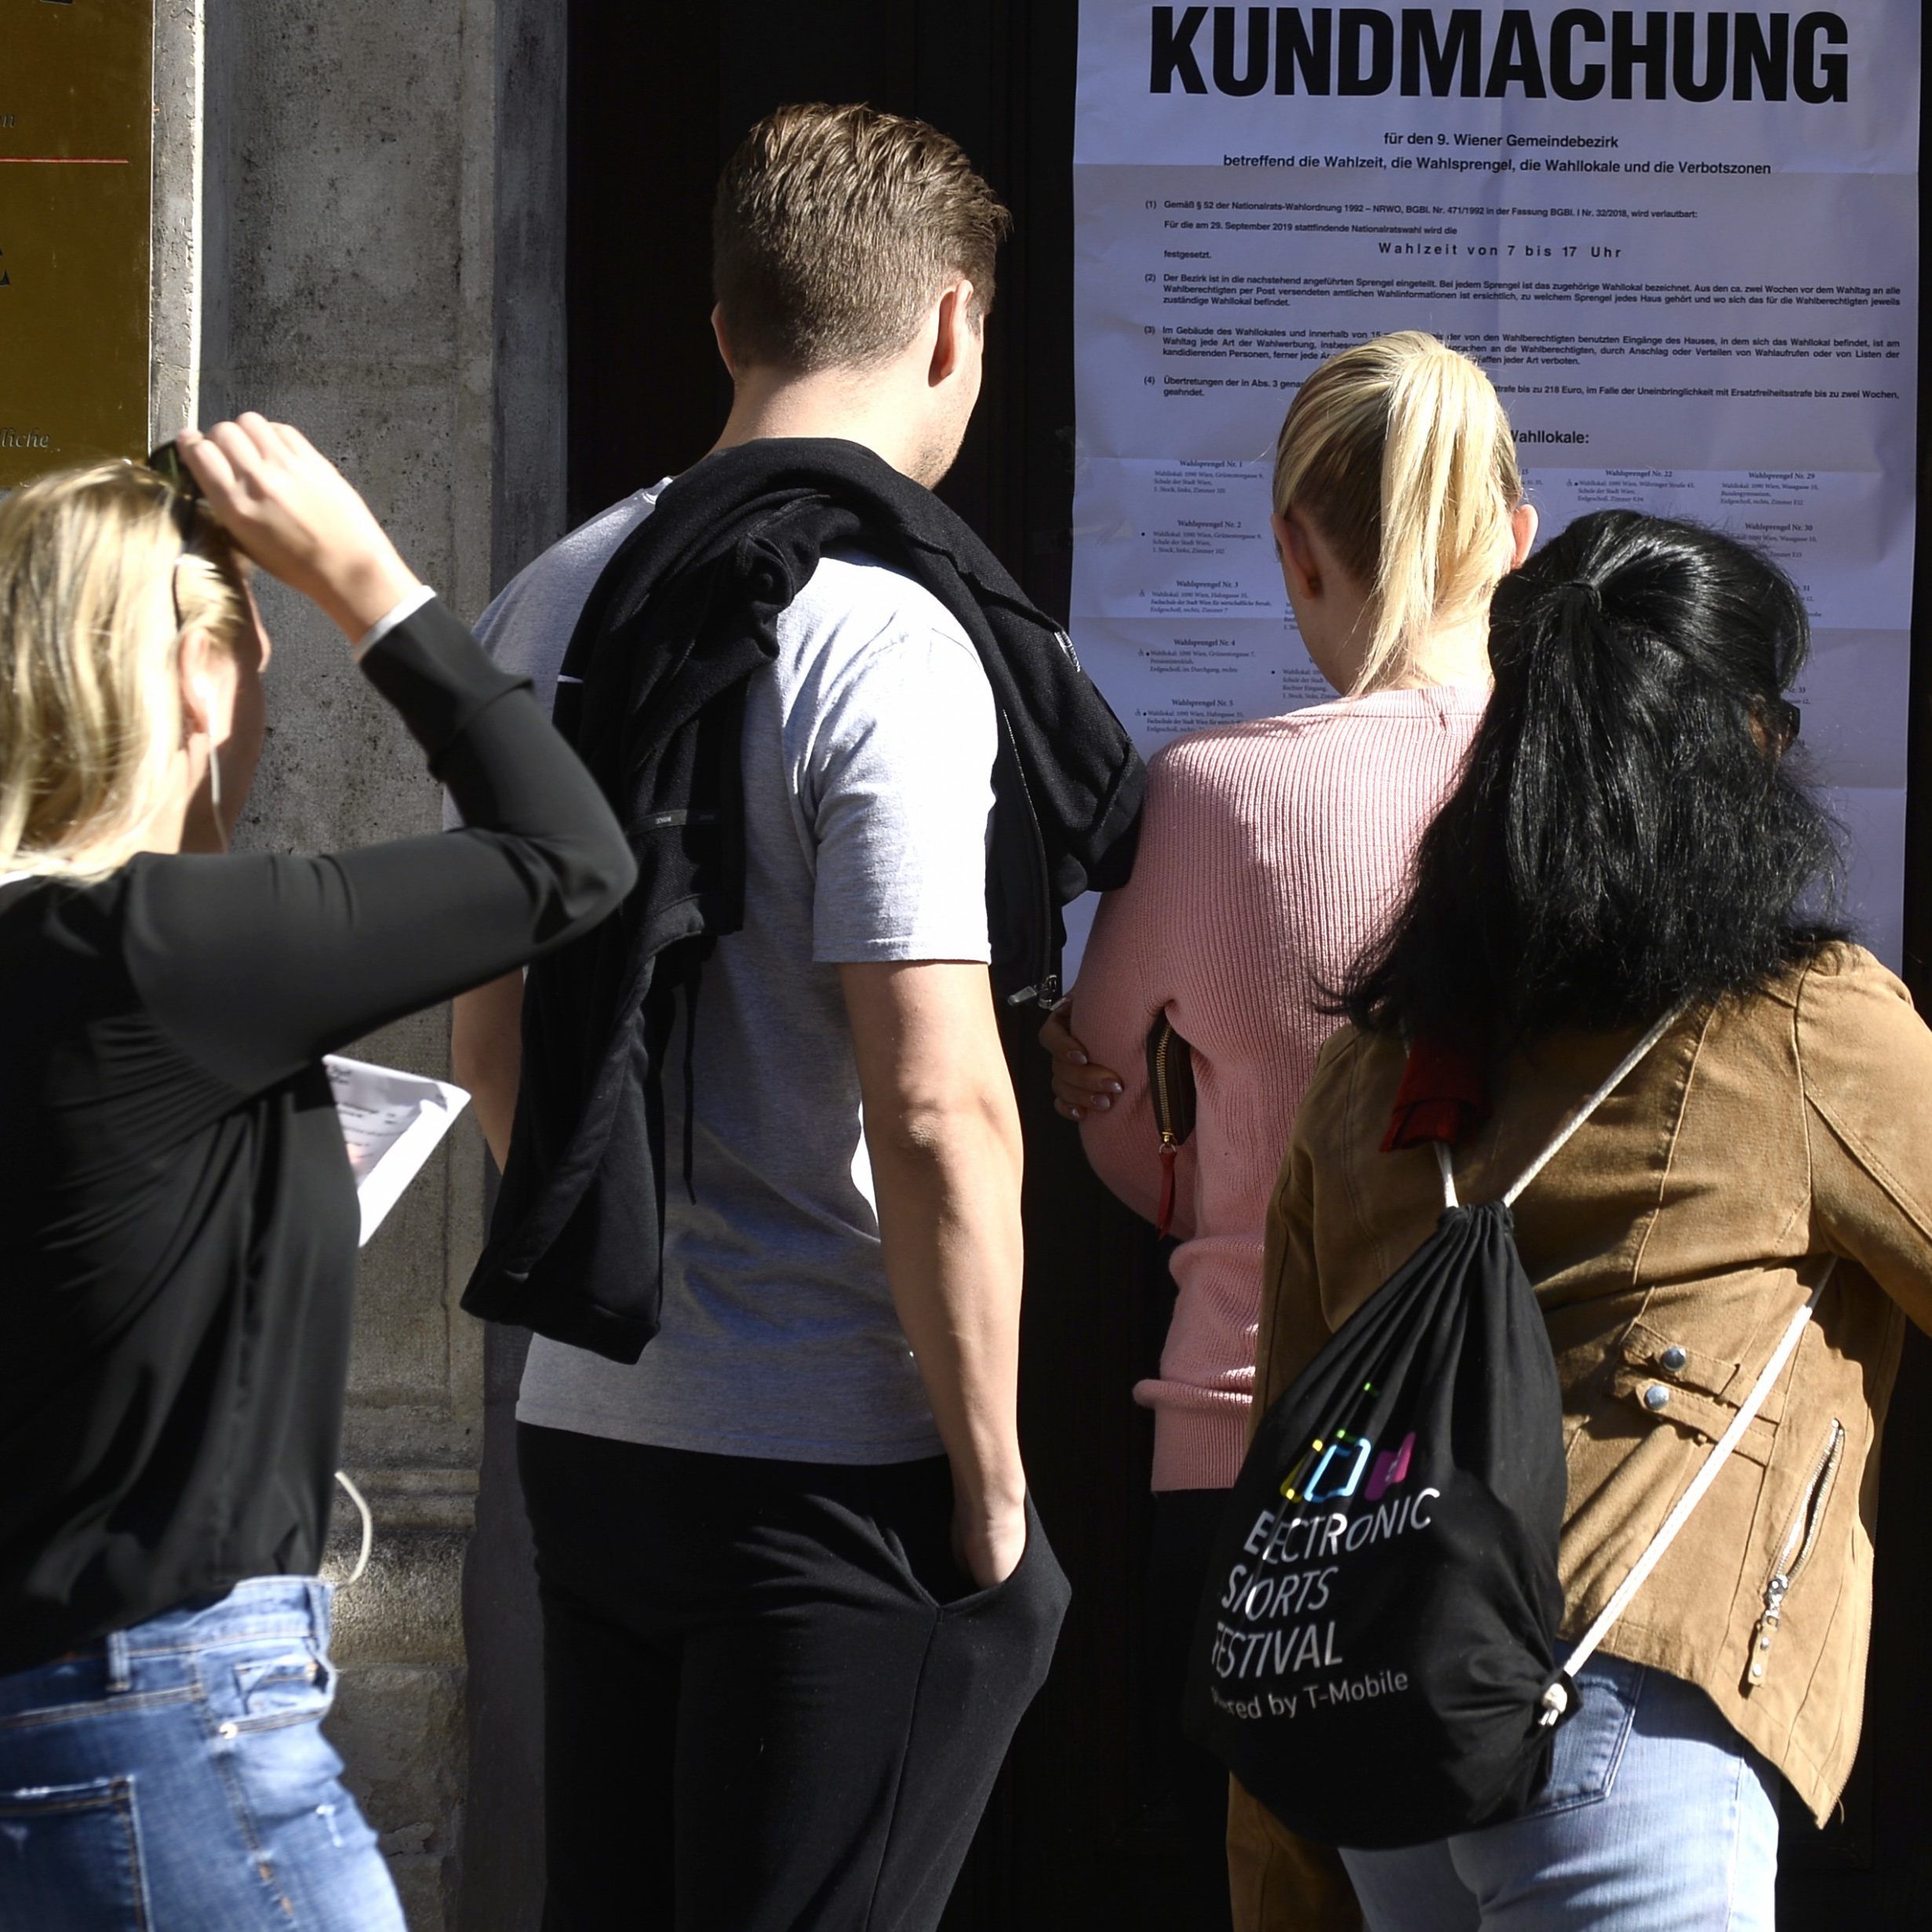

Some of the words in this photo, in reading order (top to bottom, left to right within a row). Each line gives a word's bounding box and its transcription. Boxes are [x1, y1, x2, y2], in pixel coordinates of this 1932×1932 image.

[1150, 6, 1848, 104] KUNDMACHUNG
[1384, 133, 1403, 144] für
[1407, 133, 1433, 145] den
[1437, 133, 1449, 145] 9.
[1454, 134, 1503, 146] Wiener
[1506, 135, 1618, 147] Gemeindebezirk
[1224, 155, 1295, 167] betreffend
[1299, 156, 1320, 167] die
[1324, 156, 1387, 169] Wahlzeit,
[1391, 157, 1412, 169] die
[1416, 158, 1515, 173] Wahlsprengel,
[1520, 159, 1541, 171] die
[1545, 159, 1620, 172] Wahllokale
[1625, 161, 1650, 173] und
[1654, 161, 1674, 173] die
[1679, 162, 1770, 174] Verbotszonen
[1145, 200, 1156, 209] (1)
[1216, 202, 1230, 210] der
[1232, 202, 1342, 213] Nationalrats-Wahlordnung
[1373, 205, 1403, 213] NRWO,
[1447, 206, 1484, 215] 471/1992
[1512, 208, 1548, 217] Fassung
[1181, 220, 1194, 229] die
[1225, 222, 1271, 231] September
[1294, 224, 1349, 232] stattfindende
[1352, 225, 1421, 234] Nationalratswahl
[1378, 242, 1457, 254] Wahlzeit
[1468, 247, 1497, 256] von
[1508, 245, 1515, 256] 7
[1526, 246, 1552, 257] bis
[1563, 246, 1577, 257] 17
[1592, 246, 1621, 257] Uhr
[1144, 274, 1155, 282] (2)
[1303, 278, 1354, 286] angeführten
[1356, 278, 1394, 288] Sprengel
[1395, 280, 1437, 289] eingeteilt.
[1455, 281, 1481, 289] jedem
[1483, 281, 1520, 290] Sprengel
[1552, 282, 1599, 292] zugehörige
[1836, 286, 1871, 296] Wahltag
[1163, 296, 1209, 306] zuständige
[1211, 297, 1252, 305] Wahllokal
[1144, 326, 1155, 335] (3)
[1176, 326, 1213, 335] Gebäude
[1235, 328, 1286, 337] Wahllokales
[1502, 334, 1575, 344] Wahlberechtigten
[1623, 336, 1662, 346] Eingänge
[1833, 339, 1870, 347] befindet,
[1144, 377, 1155, 385] (4)
[1164, 377, 1224, 387] Übertretungen
[1251, 379, 1270, 387] Abs.
[1562, 386, 1584, 395] Euro,
[1637, 387, 1713, 397] Uneinbringlichkeit
[1180, 459, 1224, 468] Wahlsprengel
[1748, 472, 1793, 481] Wahlsprengel
[1177, 520, 1223, 529] Wahlsprengel
[1244, 1487, 1440, 1564] EECTRONIC
[1268, 1692, 1297, 1719] by
[1304, 1669, 1408, 1709] T-Mobile
